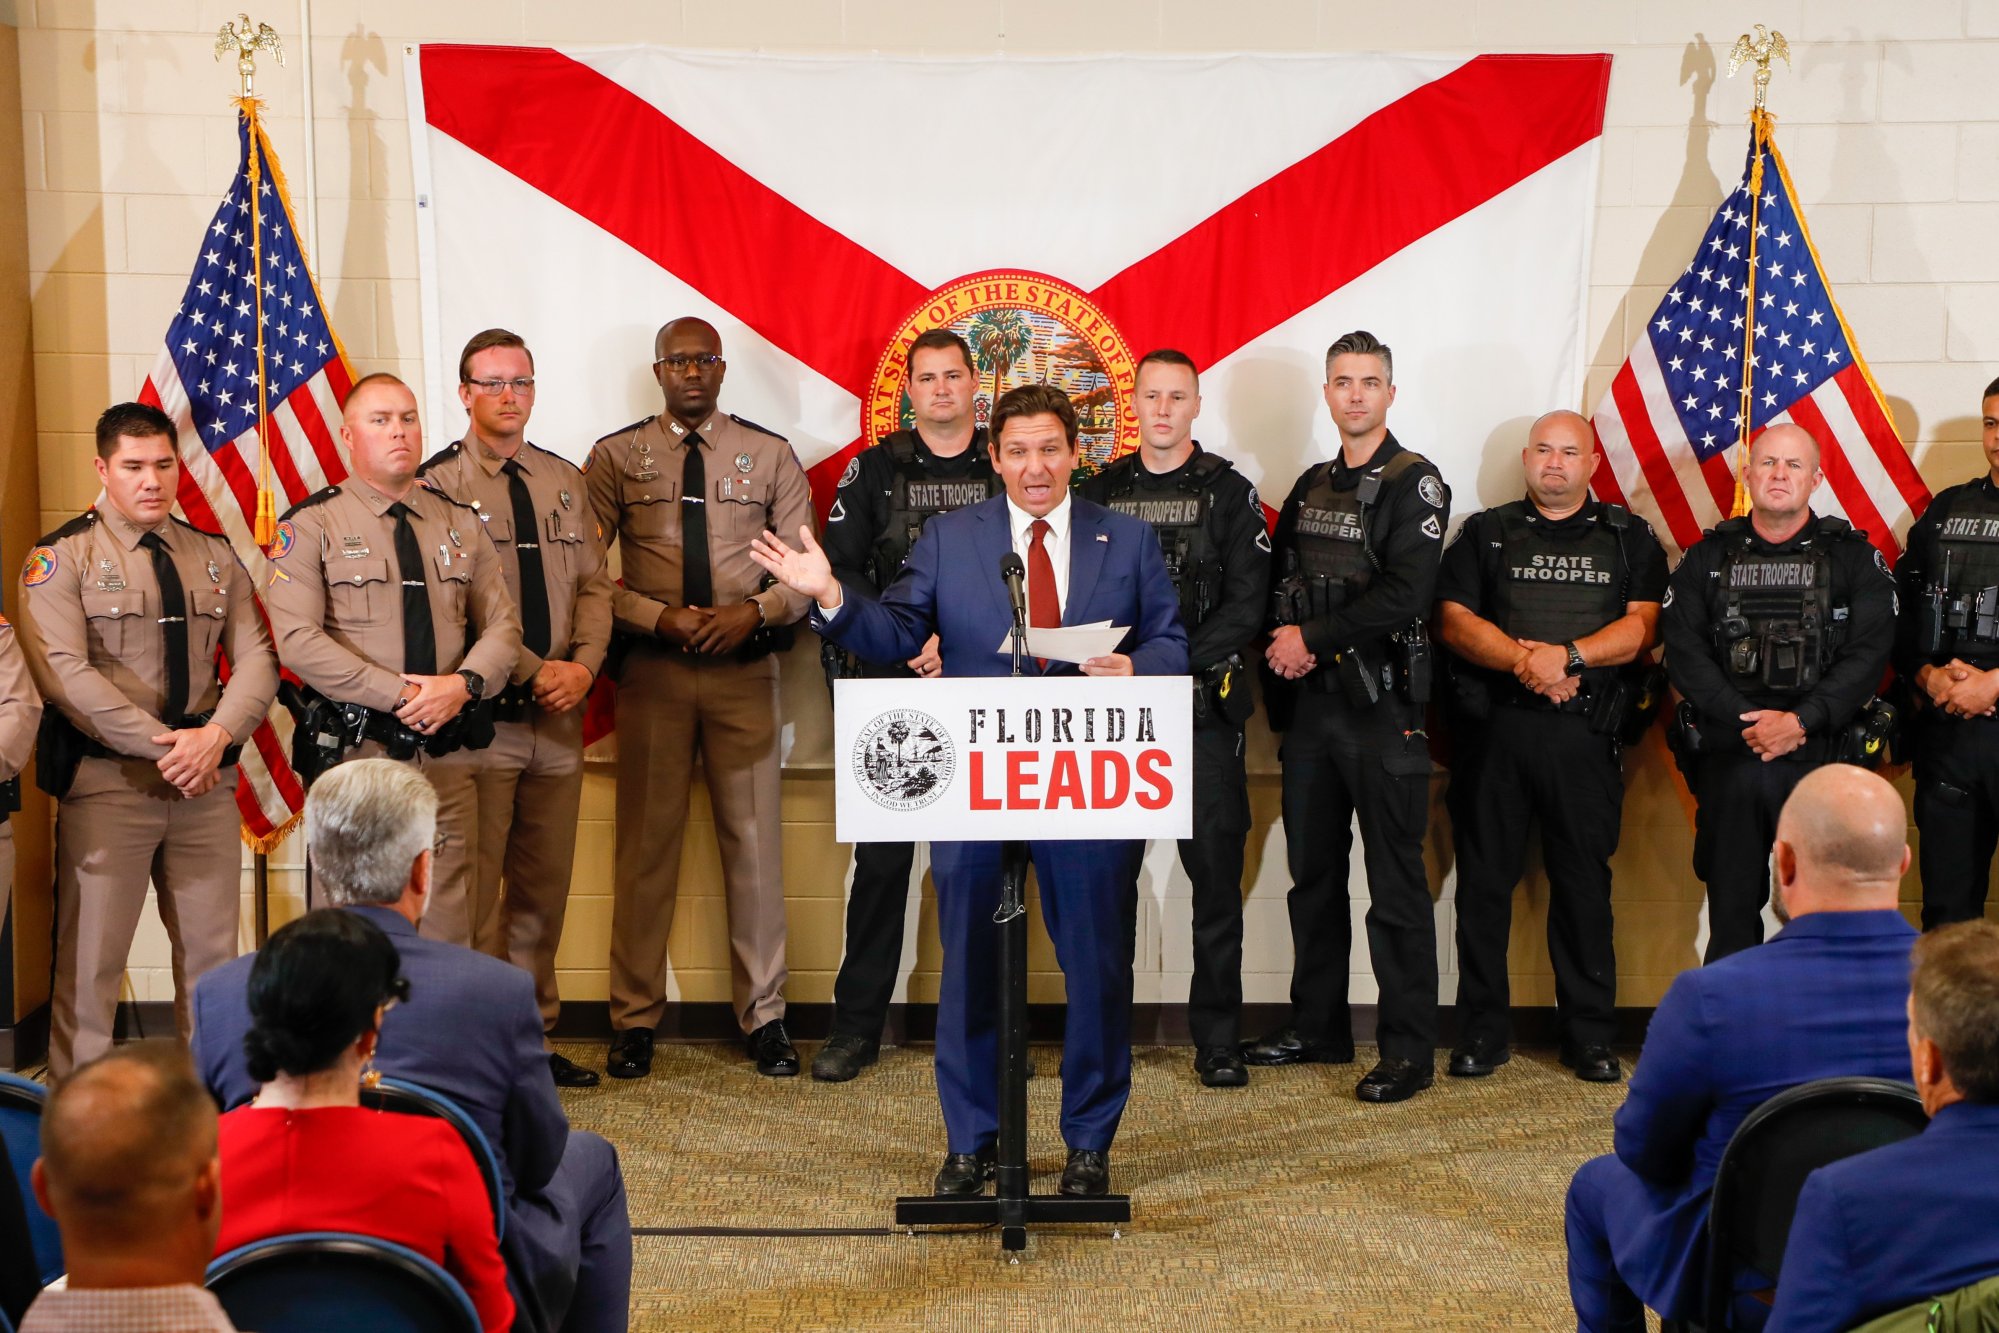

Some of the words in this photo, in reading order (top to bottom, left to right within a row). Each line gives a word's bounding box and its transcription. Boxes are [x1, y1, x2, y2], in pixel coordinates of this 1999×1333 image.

[928, 295, 959, 324] OF
[964, 283, 1019, 306] THE
[1025, 285, 1103, 337] STATE
[1099, 335, 1126, 366] OF
[909, 484, 940, 507] STATE
[941, 483, 986, 506] TROOPER
[1139, 501, 1184, 522] TROOPER
[1184, 500, 1198, 522] K9
[1303, 507, 1358, 526] STATE
[1297, 519, 1362, 540] TROOPER
[1943, 517, 1980, 536] STATE
[1531, 555, 1592, 569] STATE
[1512, 567, 1611, 584] TROOPER
[1731, 564, 1759, 586] STATE
[1760, 562, 1800, 586] TROOPER
[1801, 563, 1814, 587] K9
[888, 712, 904, 721] THE
[969, 707, 1156, 743] FLORIDA
[969, 749, 1174, 810] LEADS
